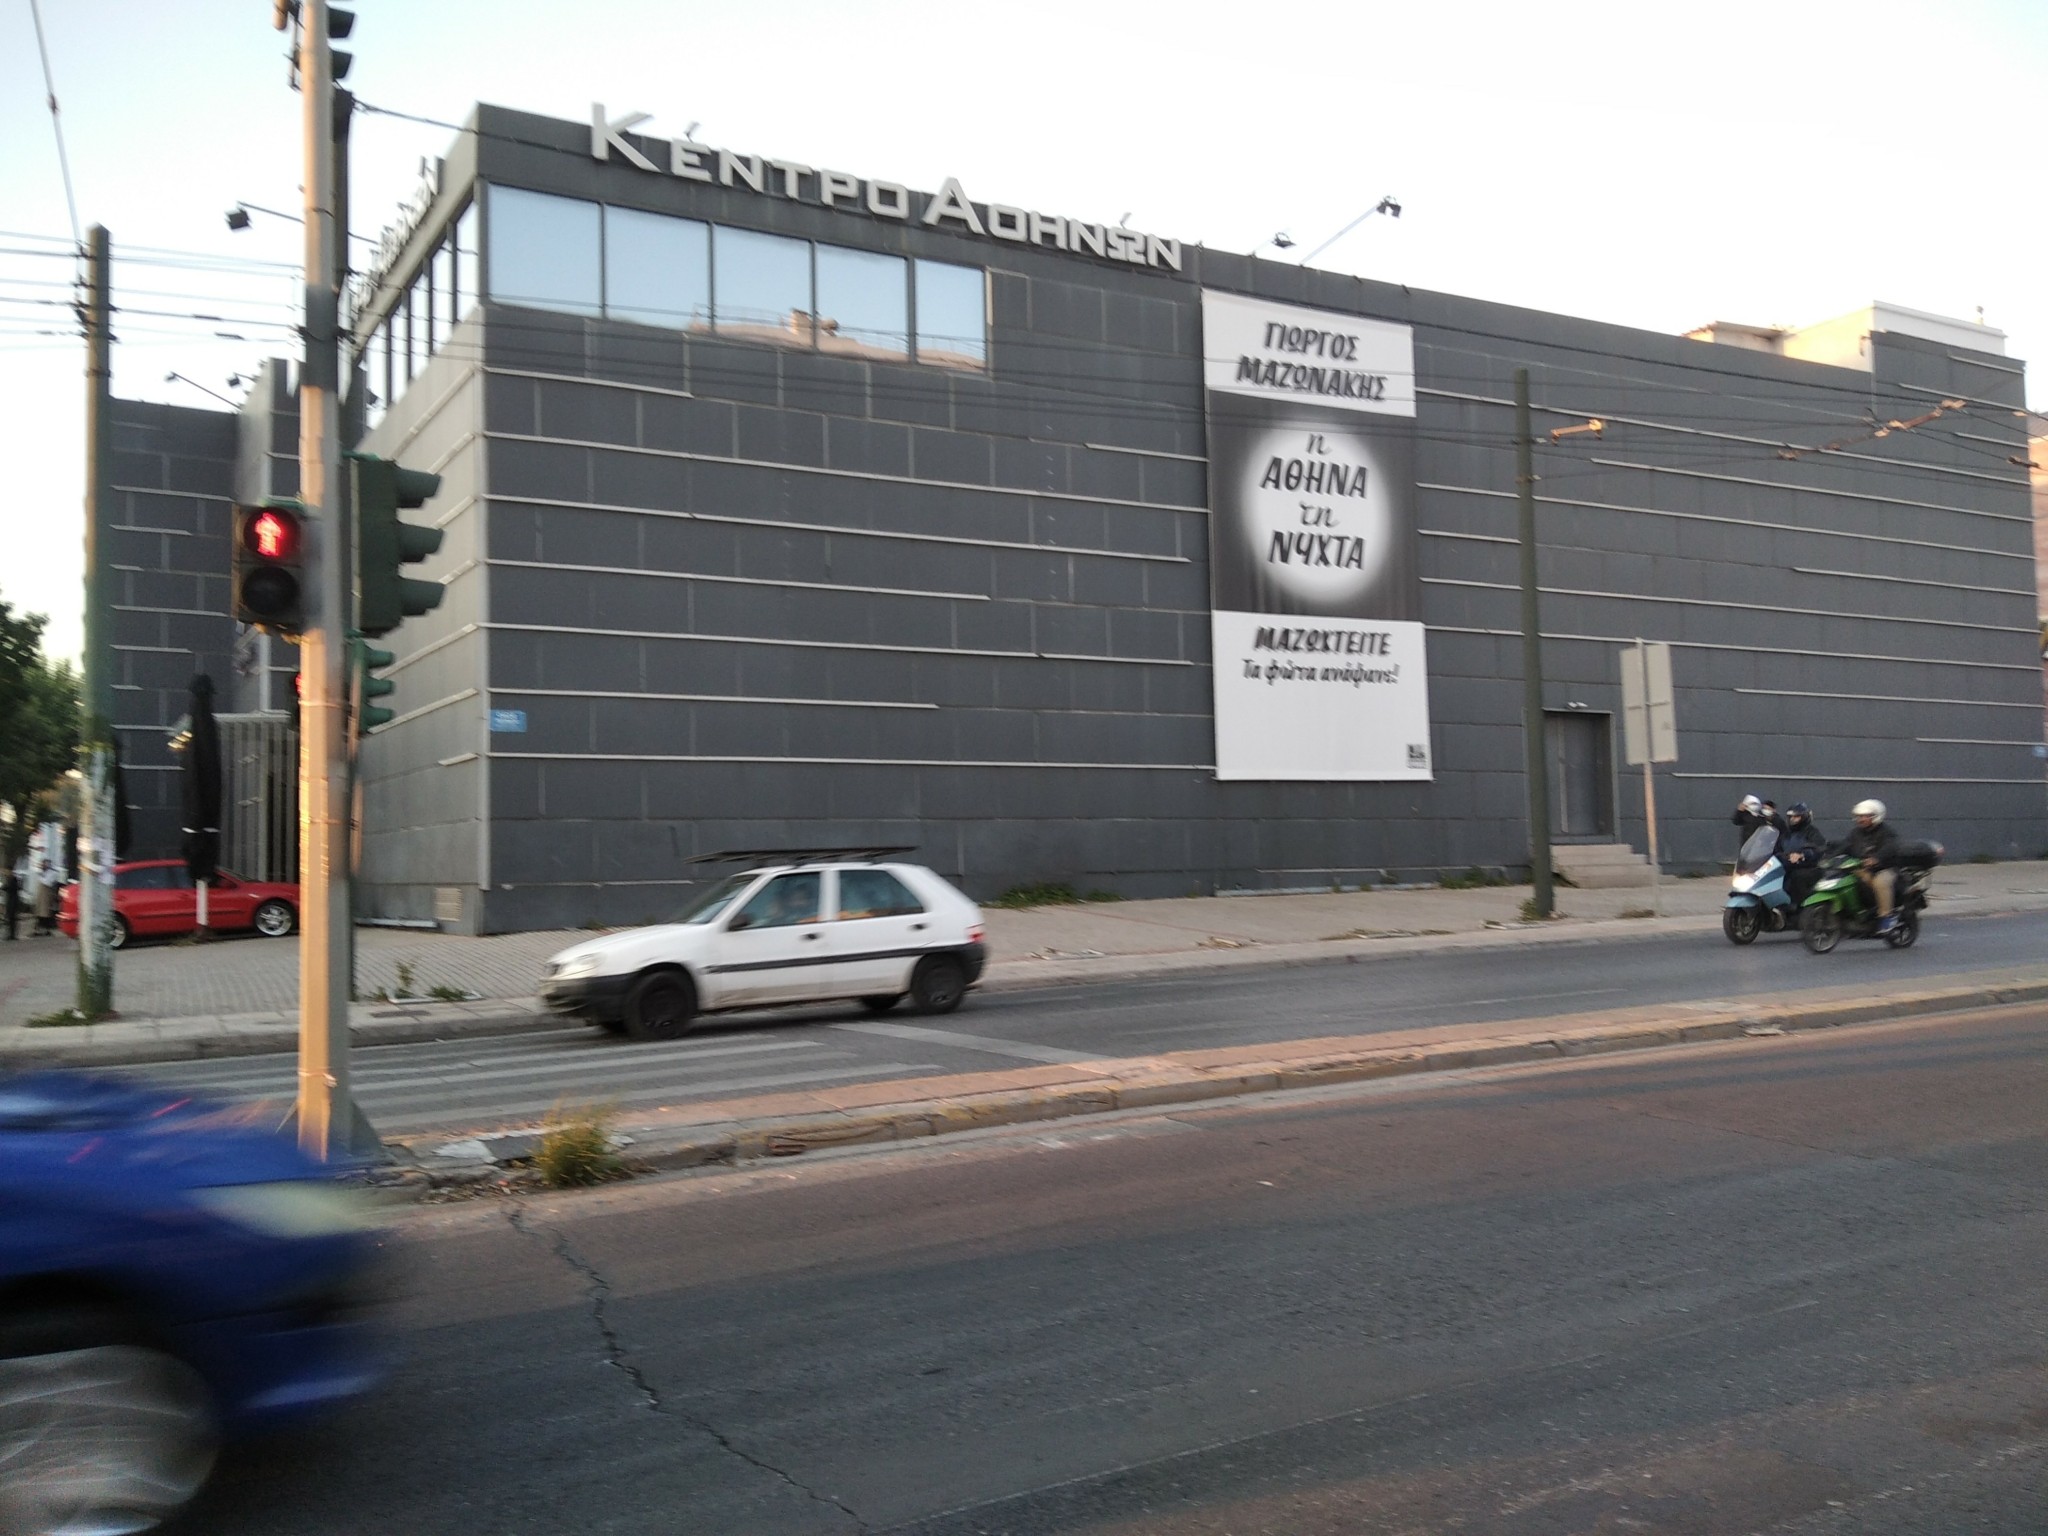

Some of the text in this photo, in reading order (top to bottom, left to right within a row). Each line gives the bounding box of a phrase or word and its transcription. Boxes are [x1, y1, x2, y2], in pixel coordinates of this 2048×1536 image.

[1263, 321, 1360, 361] ΓΙΩΡΓΟΣ
[1236, 354, 1388, 401] ΜΑΖΩΝΑΚΗΣ
[1259, 455, 1368, 499] ΑΘΗΝΑ
[1300, 501, 1341, 528] τη
[1267, 529, 1366, 571] ΝΥΧΤΑ
[1253, 626, 1392, 655] ΜΑΖΩΧΤΕΙΤΕ
[1243, 658, 1262, 680] Τα
